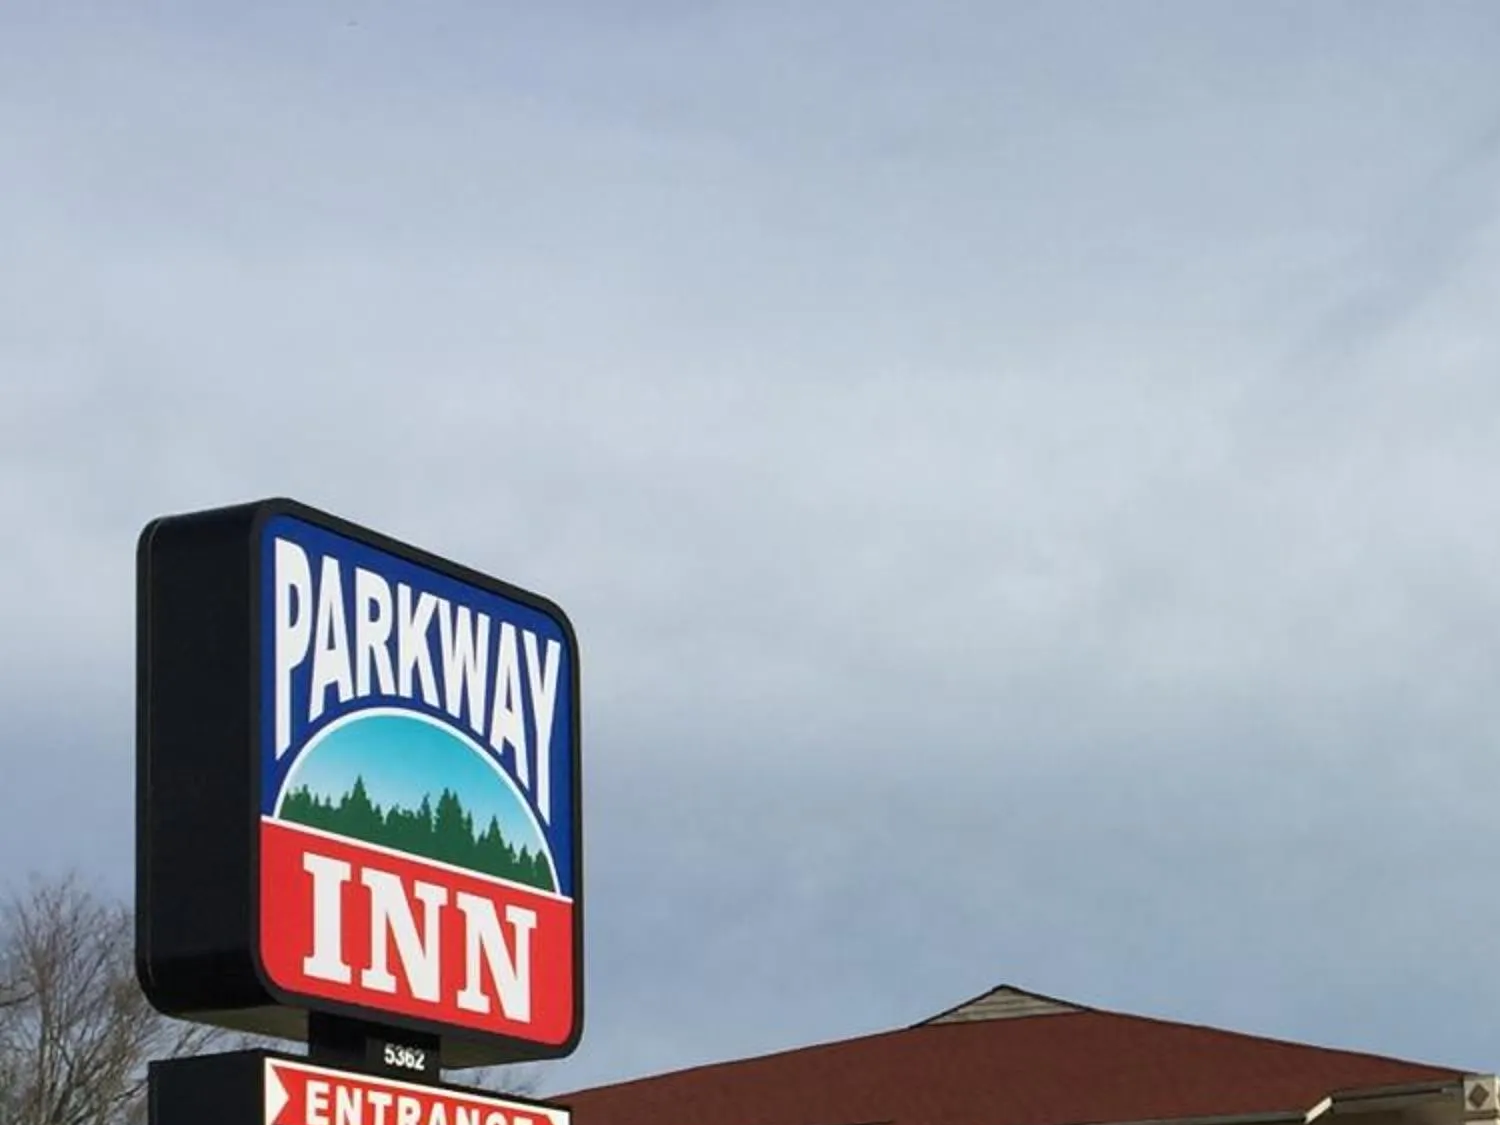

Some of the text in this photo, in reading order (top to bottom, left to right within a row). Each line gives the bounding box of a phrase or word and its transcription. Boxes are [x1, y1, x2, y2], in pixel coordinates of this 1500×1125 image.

[275, 537, 561, 826] PARKWAY
[303, 851, 536, 1024] INN
[384, 1044, 425, 1071] 5362
